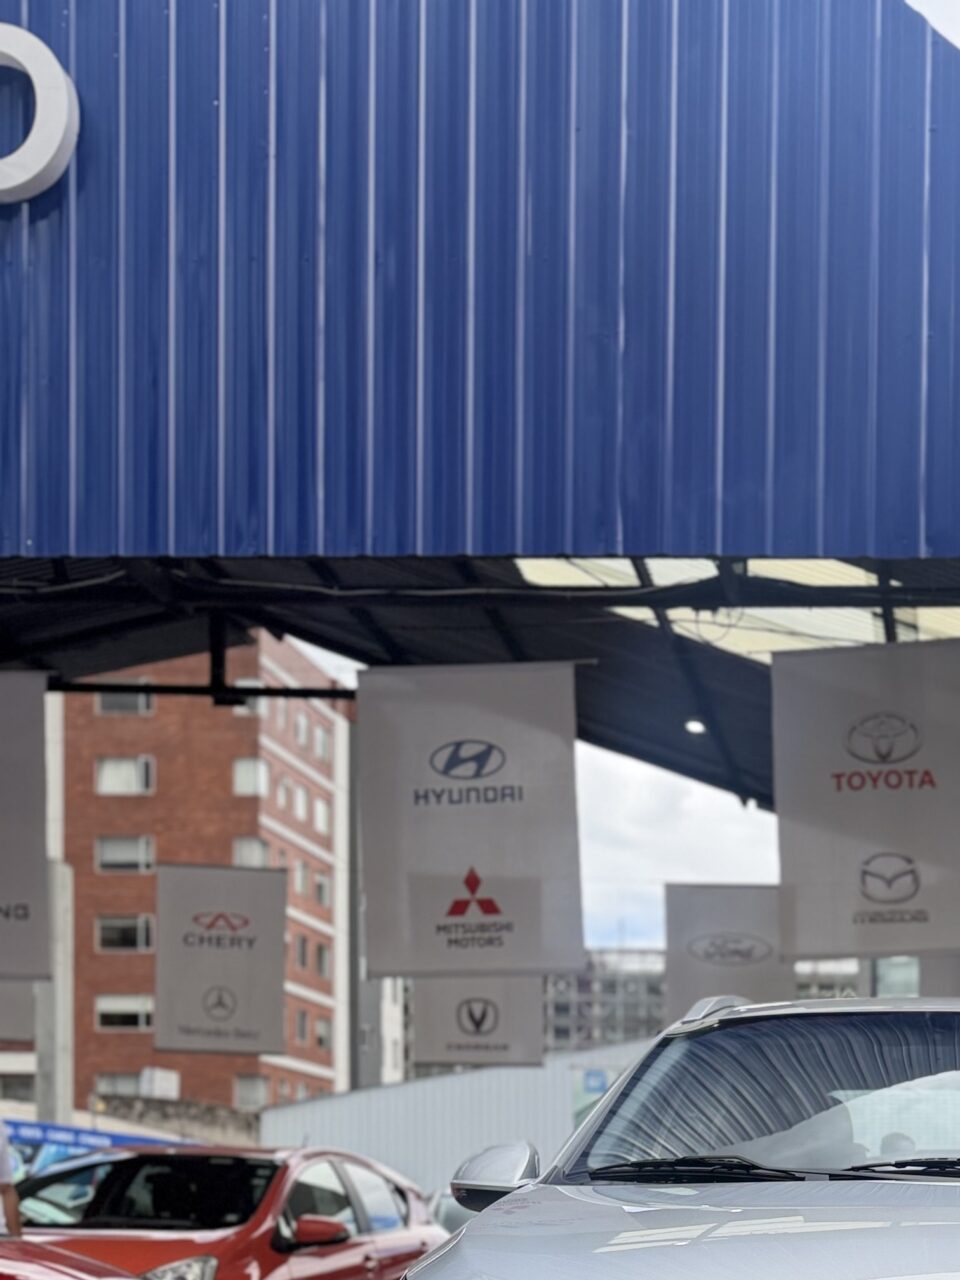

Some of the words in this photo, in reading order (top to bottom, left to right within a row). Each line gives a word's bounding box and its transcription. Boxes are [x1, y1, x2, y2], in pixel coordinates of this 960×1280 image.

[831, 769, 937, 793] TOYOTA
[413, 785, 524, 806] HYUNDAI
[435, 921, 514, 935] MITSUBISHI
[182, 932, 258, 950] CHERY
[446, 935, 505, 949] MOTORS
